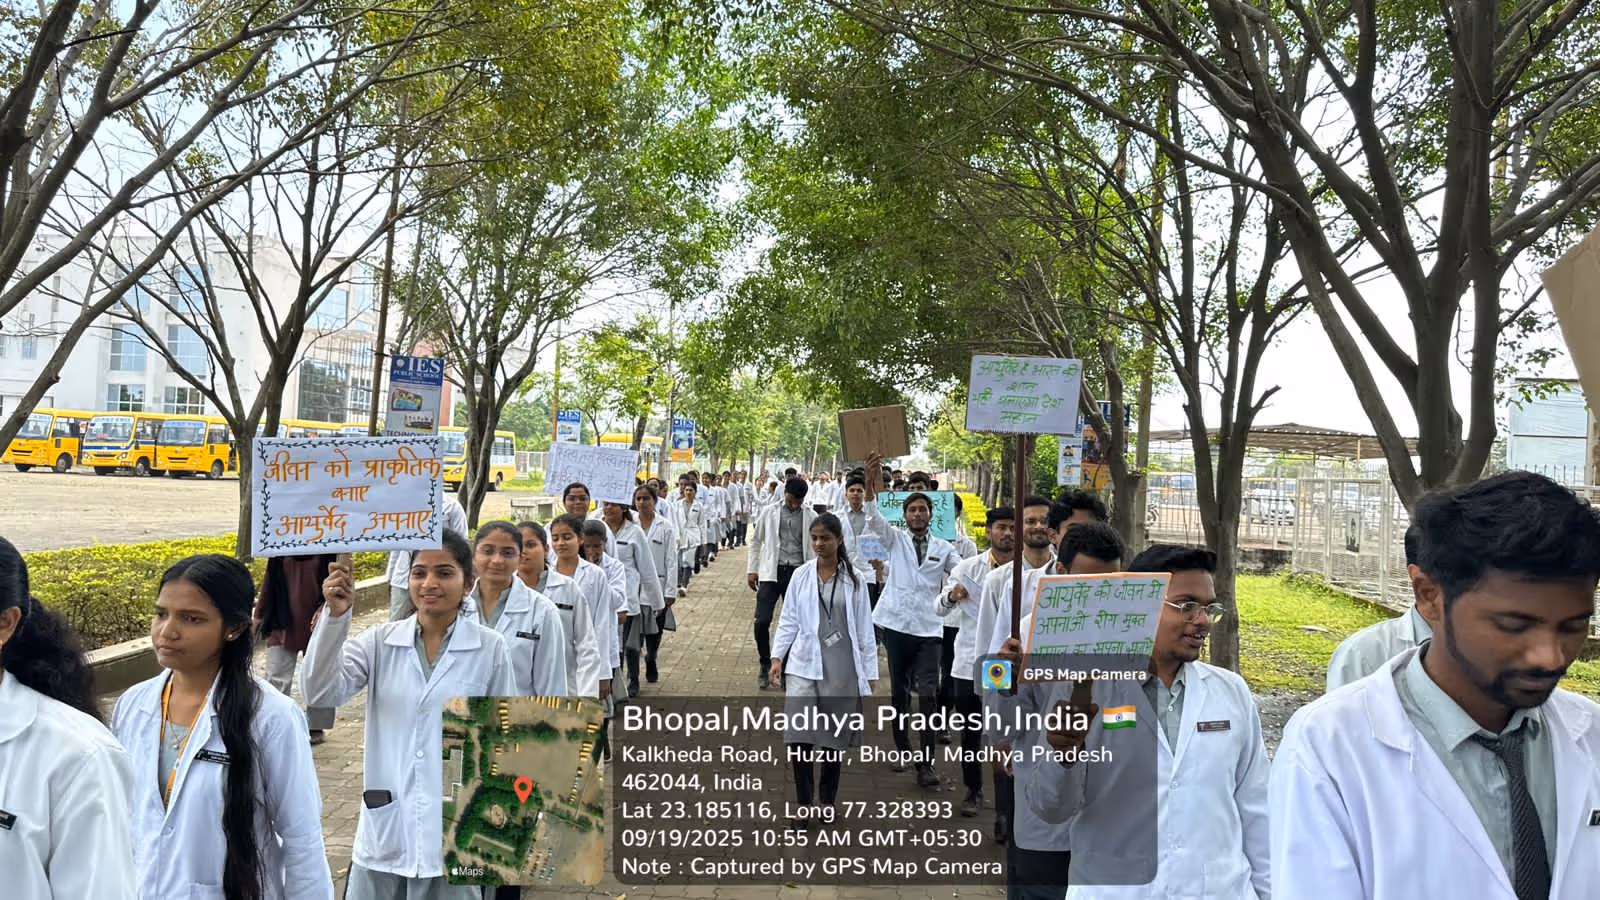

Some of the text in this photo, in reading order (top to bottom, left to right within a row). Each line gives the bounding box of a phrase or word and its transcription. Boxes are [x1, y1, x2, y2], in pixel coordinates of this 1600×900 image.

[408, 357, 441, 374] IES
[263, 450, 317, 482] जीवन
[324, 449, 352, 478] को
[332, 485, 371, 502] बनाए
[275, 505, 433, 543] आयुर्वेद अपनाए
